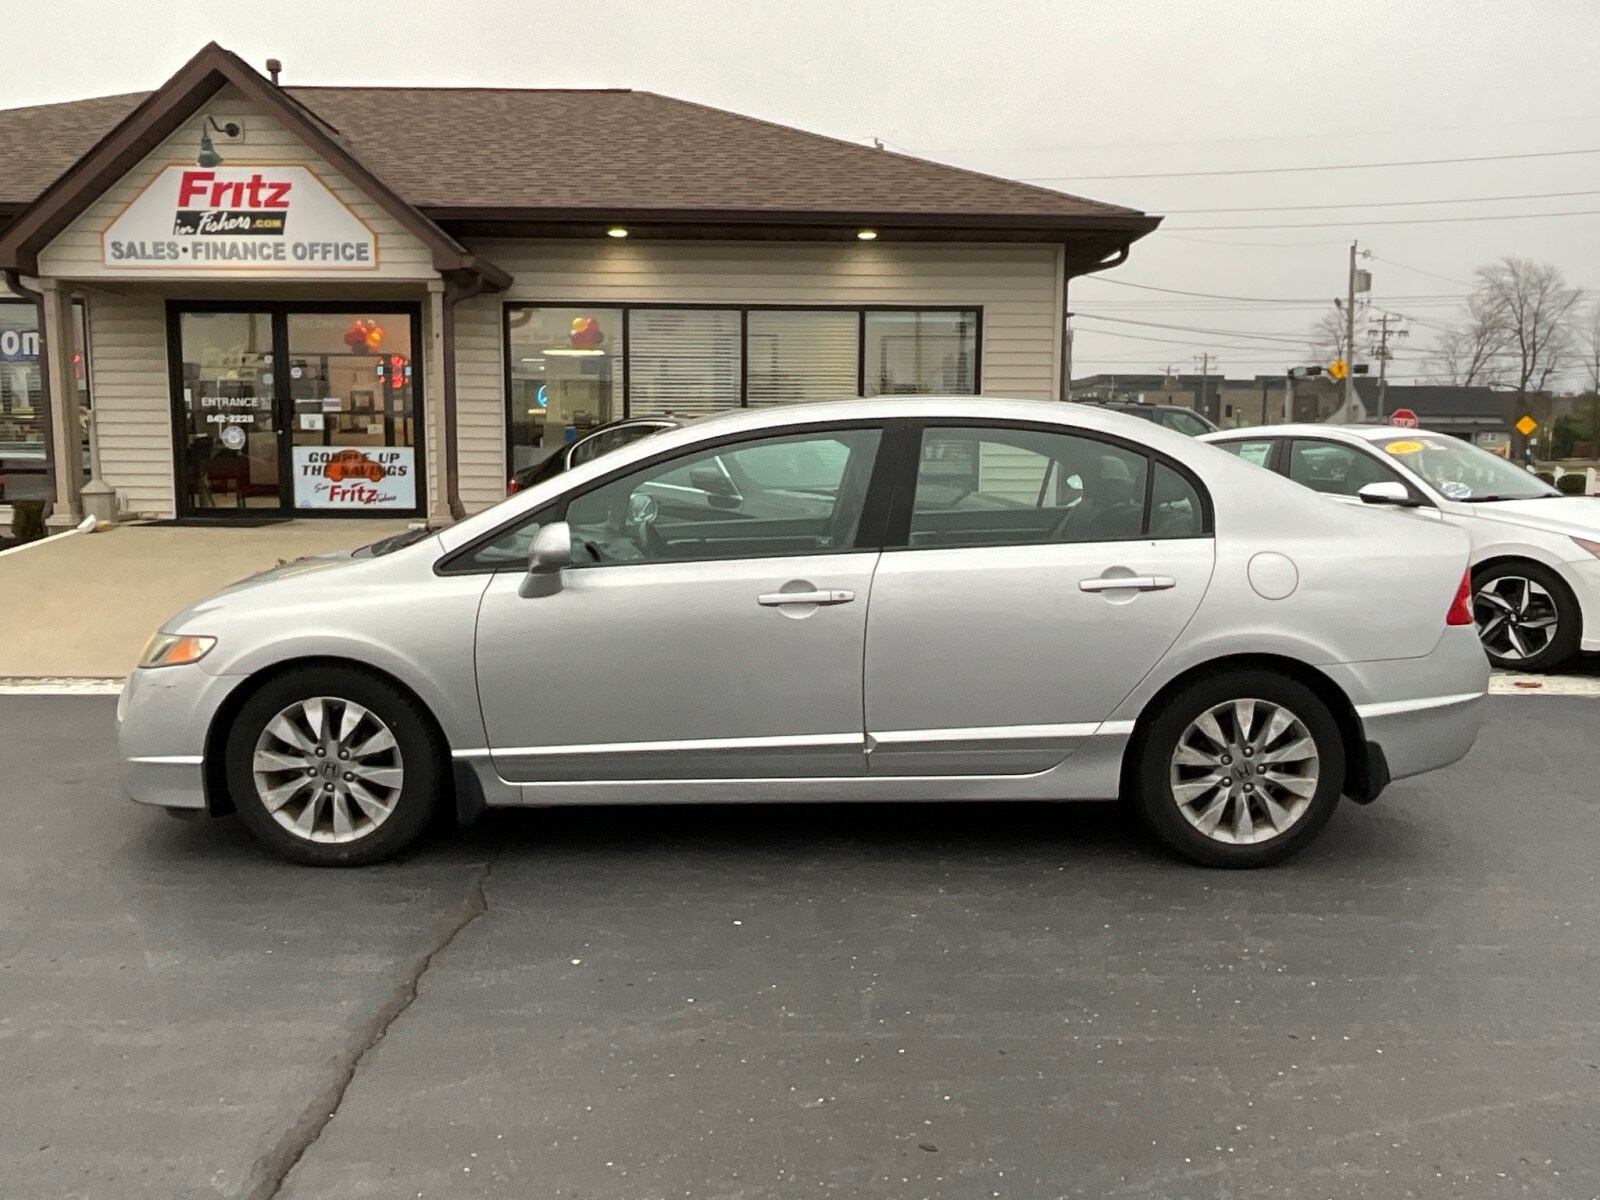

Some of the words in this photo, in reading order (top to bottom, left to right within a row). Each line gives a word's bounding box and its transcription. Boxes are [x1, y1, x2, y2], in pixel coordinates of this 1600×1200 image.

[178, 171, 292, 208] Fritz
[174, 219, 194, 235] in
[197, 210, 251, 235] Fishers
[110, 241, 180, 260] SALES
[191, 242, 286, 260] FINANCE
[292, 242, 370, 261] OFFICE
[202, 397, 258, 407] ENTRANCE
[1392, 417, 1416, 428] STOP
[379, 452, 400, 464] UP
[328, 482, 379, 504] Fritz
